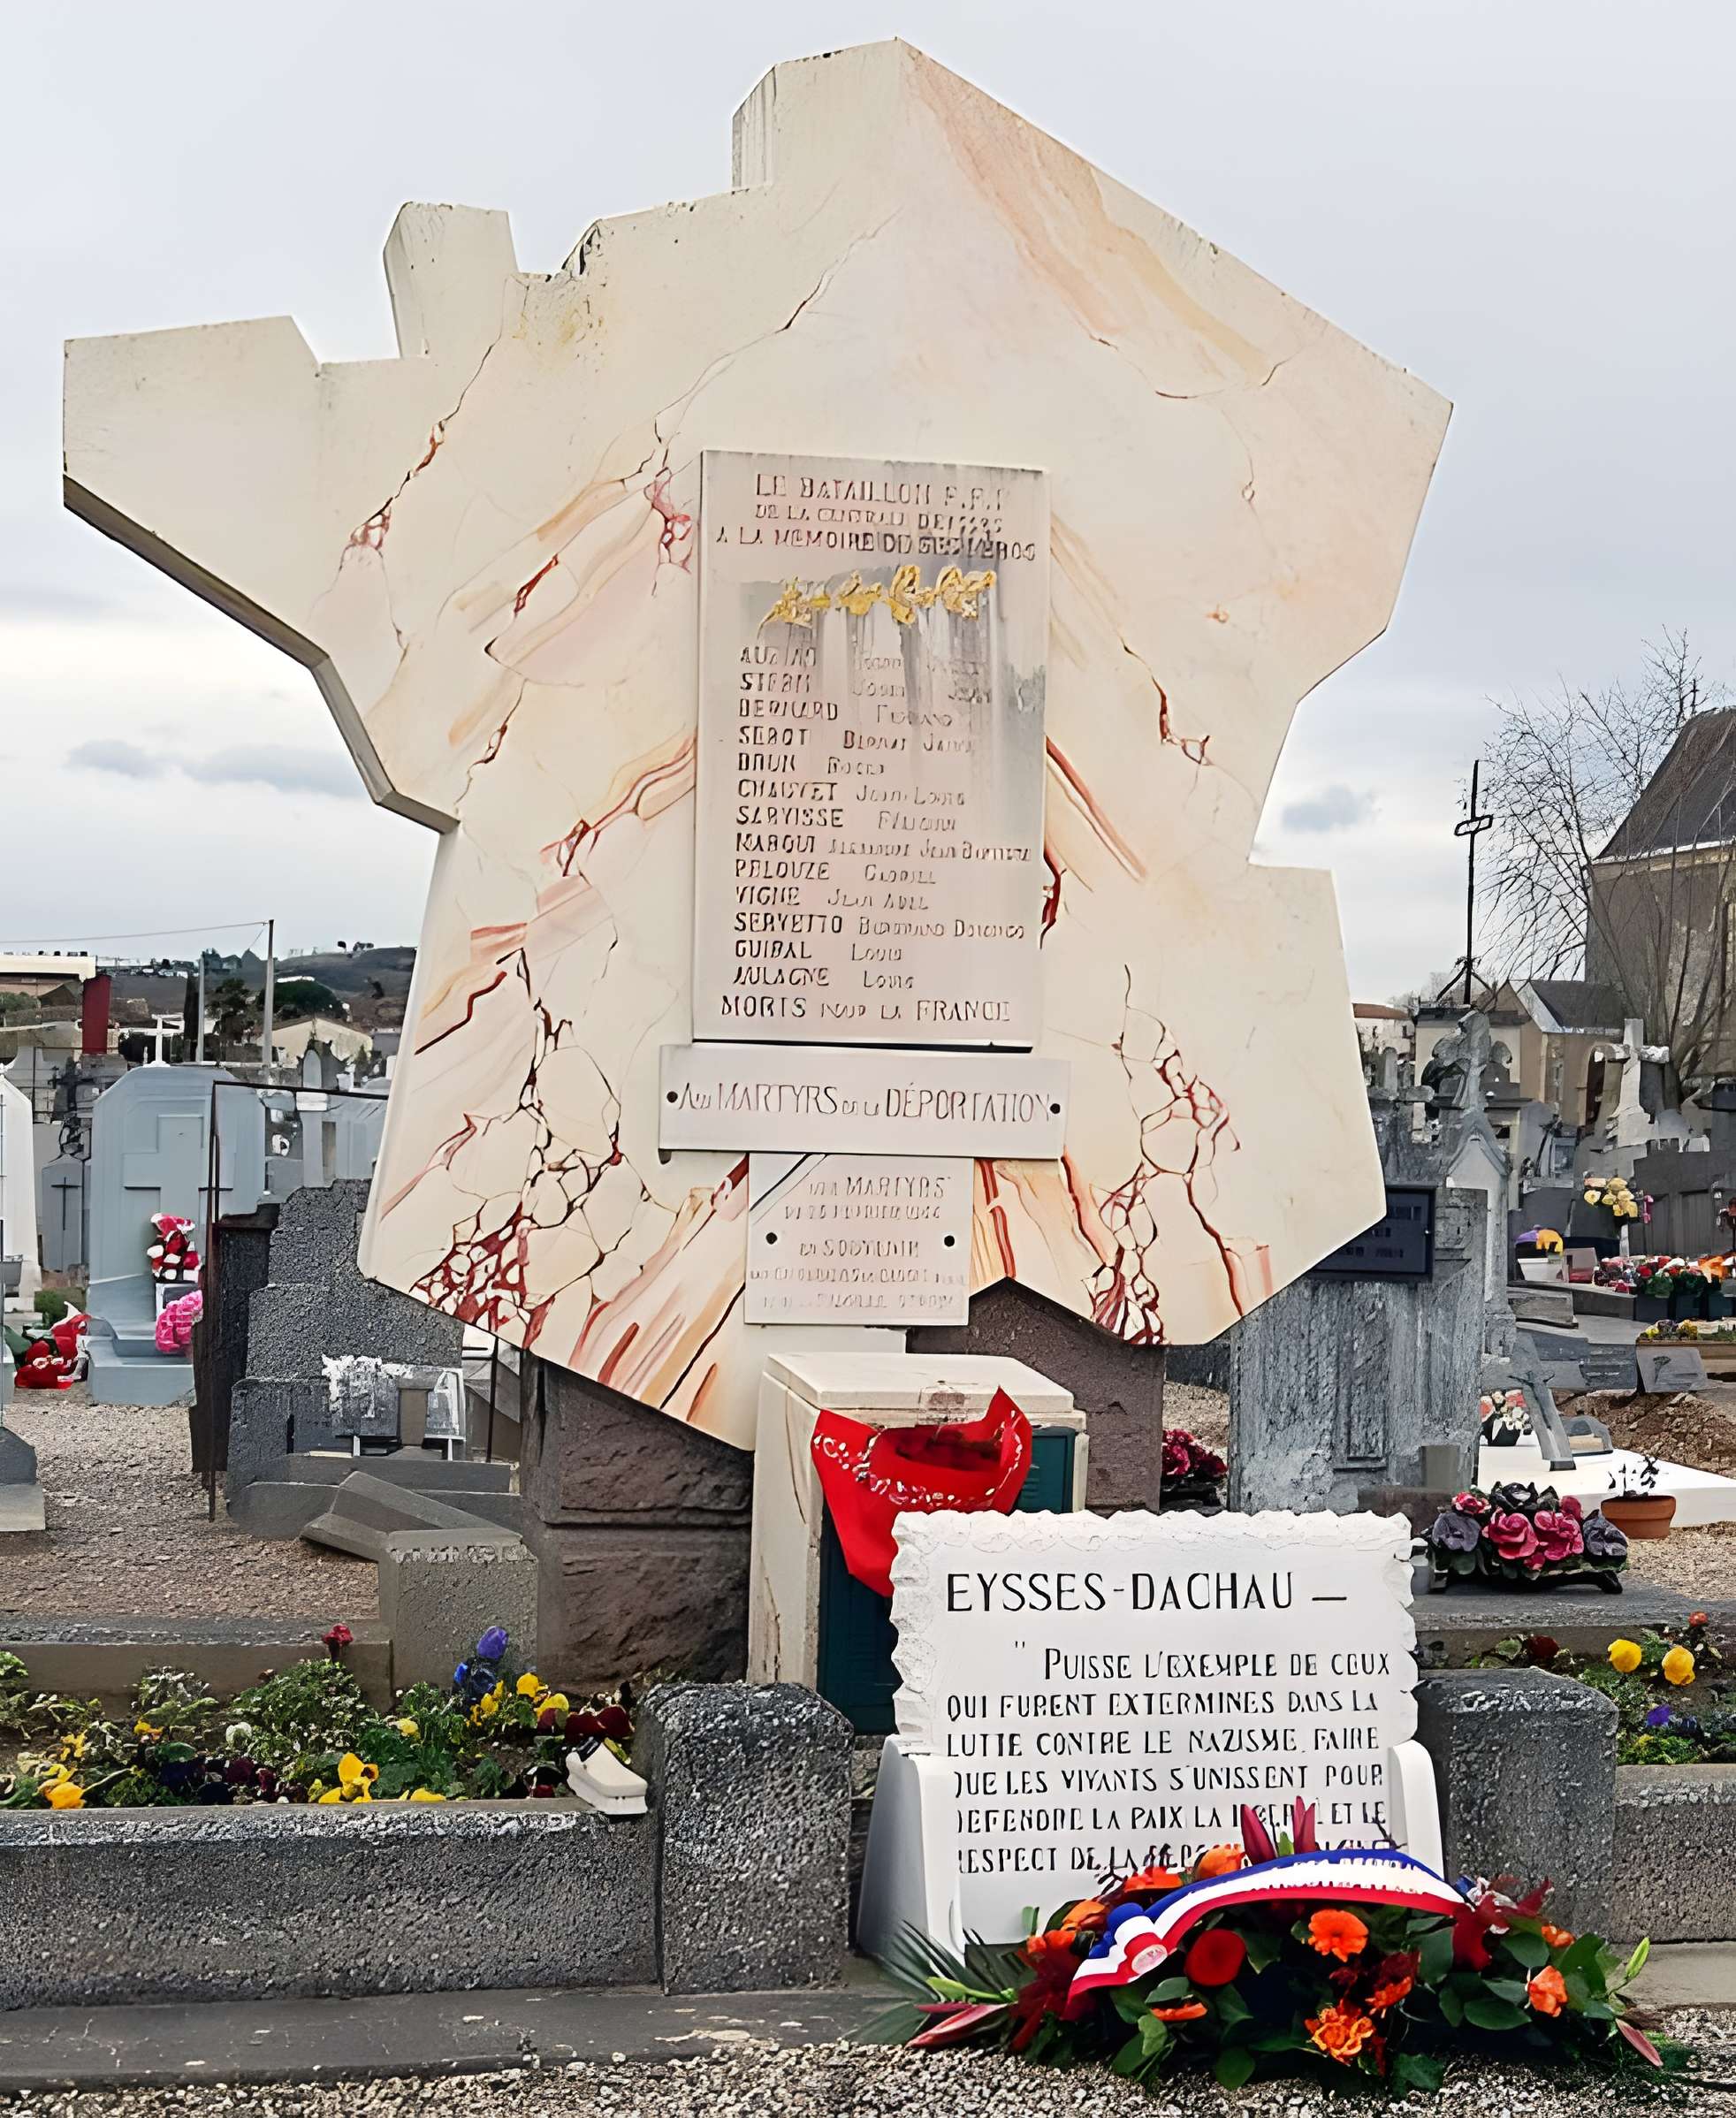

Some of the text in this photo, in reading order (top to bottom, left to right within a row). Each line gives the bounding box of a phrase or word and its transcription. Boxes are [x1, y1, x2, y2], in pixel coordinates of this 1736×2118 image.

[718, 1083, 838, 1116] MARTYRS
[946, 1571, 1294, 1611] EYSSES-DACHAU
[1290, 1653, 1318, 1677] DE
[1330, 1652, 1390, 1677] CEUX
[947, 1688, 1379, 1722] QUI FURENT EXTERMINES DANS LA
[947, 1732, 1023, 1757] LUTTE
[1035, 1731, 1132, 1756] CONTRE
[1144, 1730, 1173, 1756] LE
[1313, 1726, 1381, 1751] FAIRE
[1006, 1770, 1049, 1796] LES
[1061, 1767, 1158, 1794] VIVANTS
[1325, 1763, 1384, 1787] POUR
[1092, 1807, 1122, 1831] LA
[1131, 1806, 1184, 1830] PAIX
[1193, 1804, 1222, 1828] LA
[1330, 1802, 1354, 1825] ET
[1070, 1844, 1102, 1871] DE
